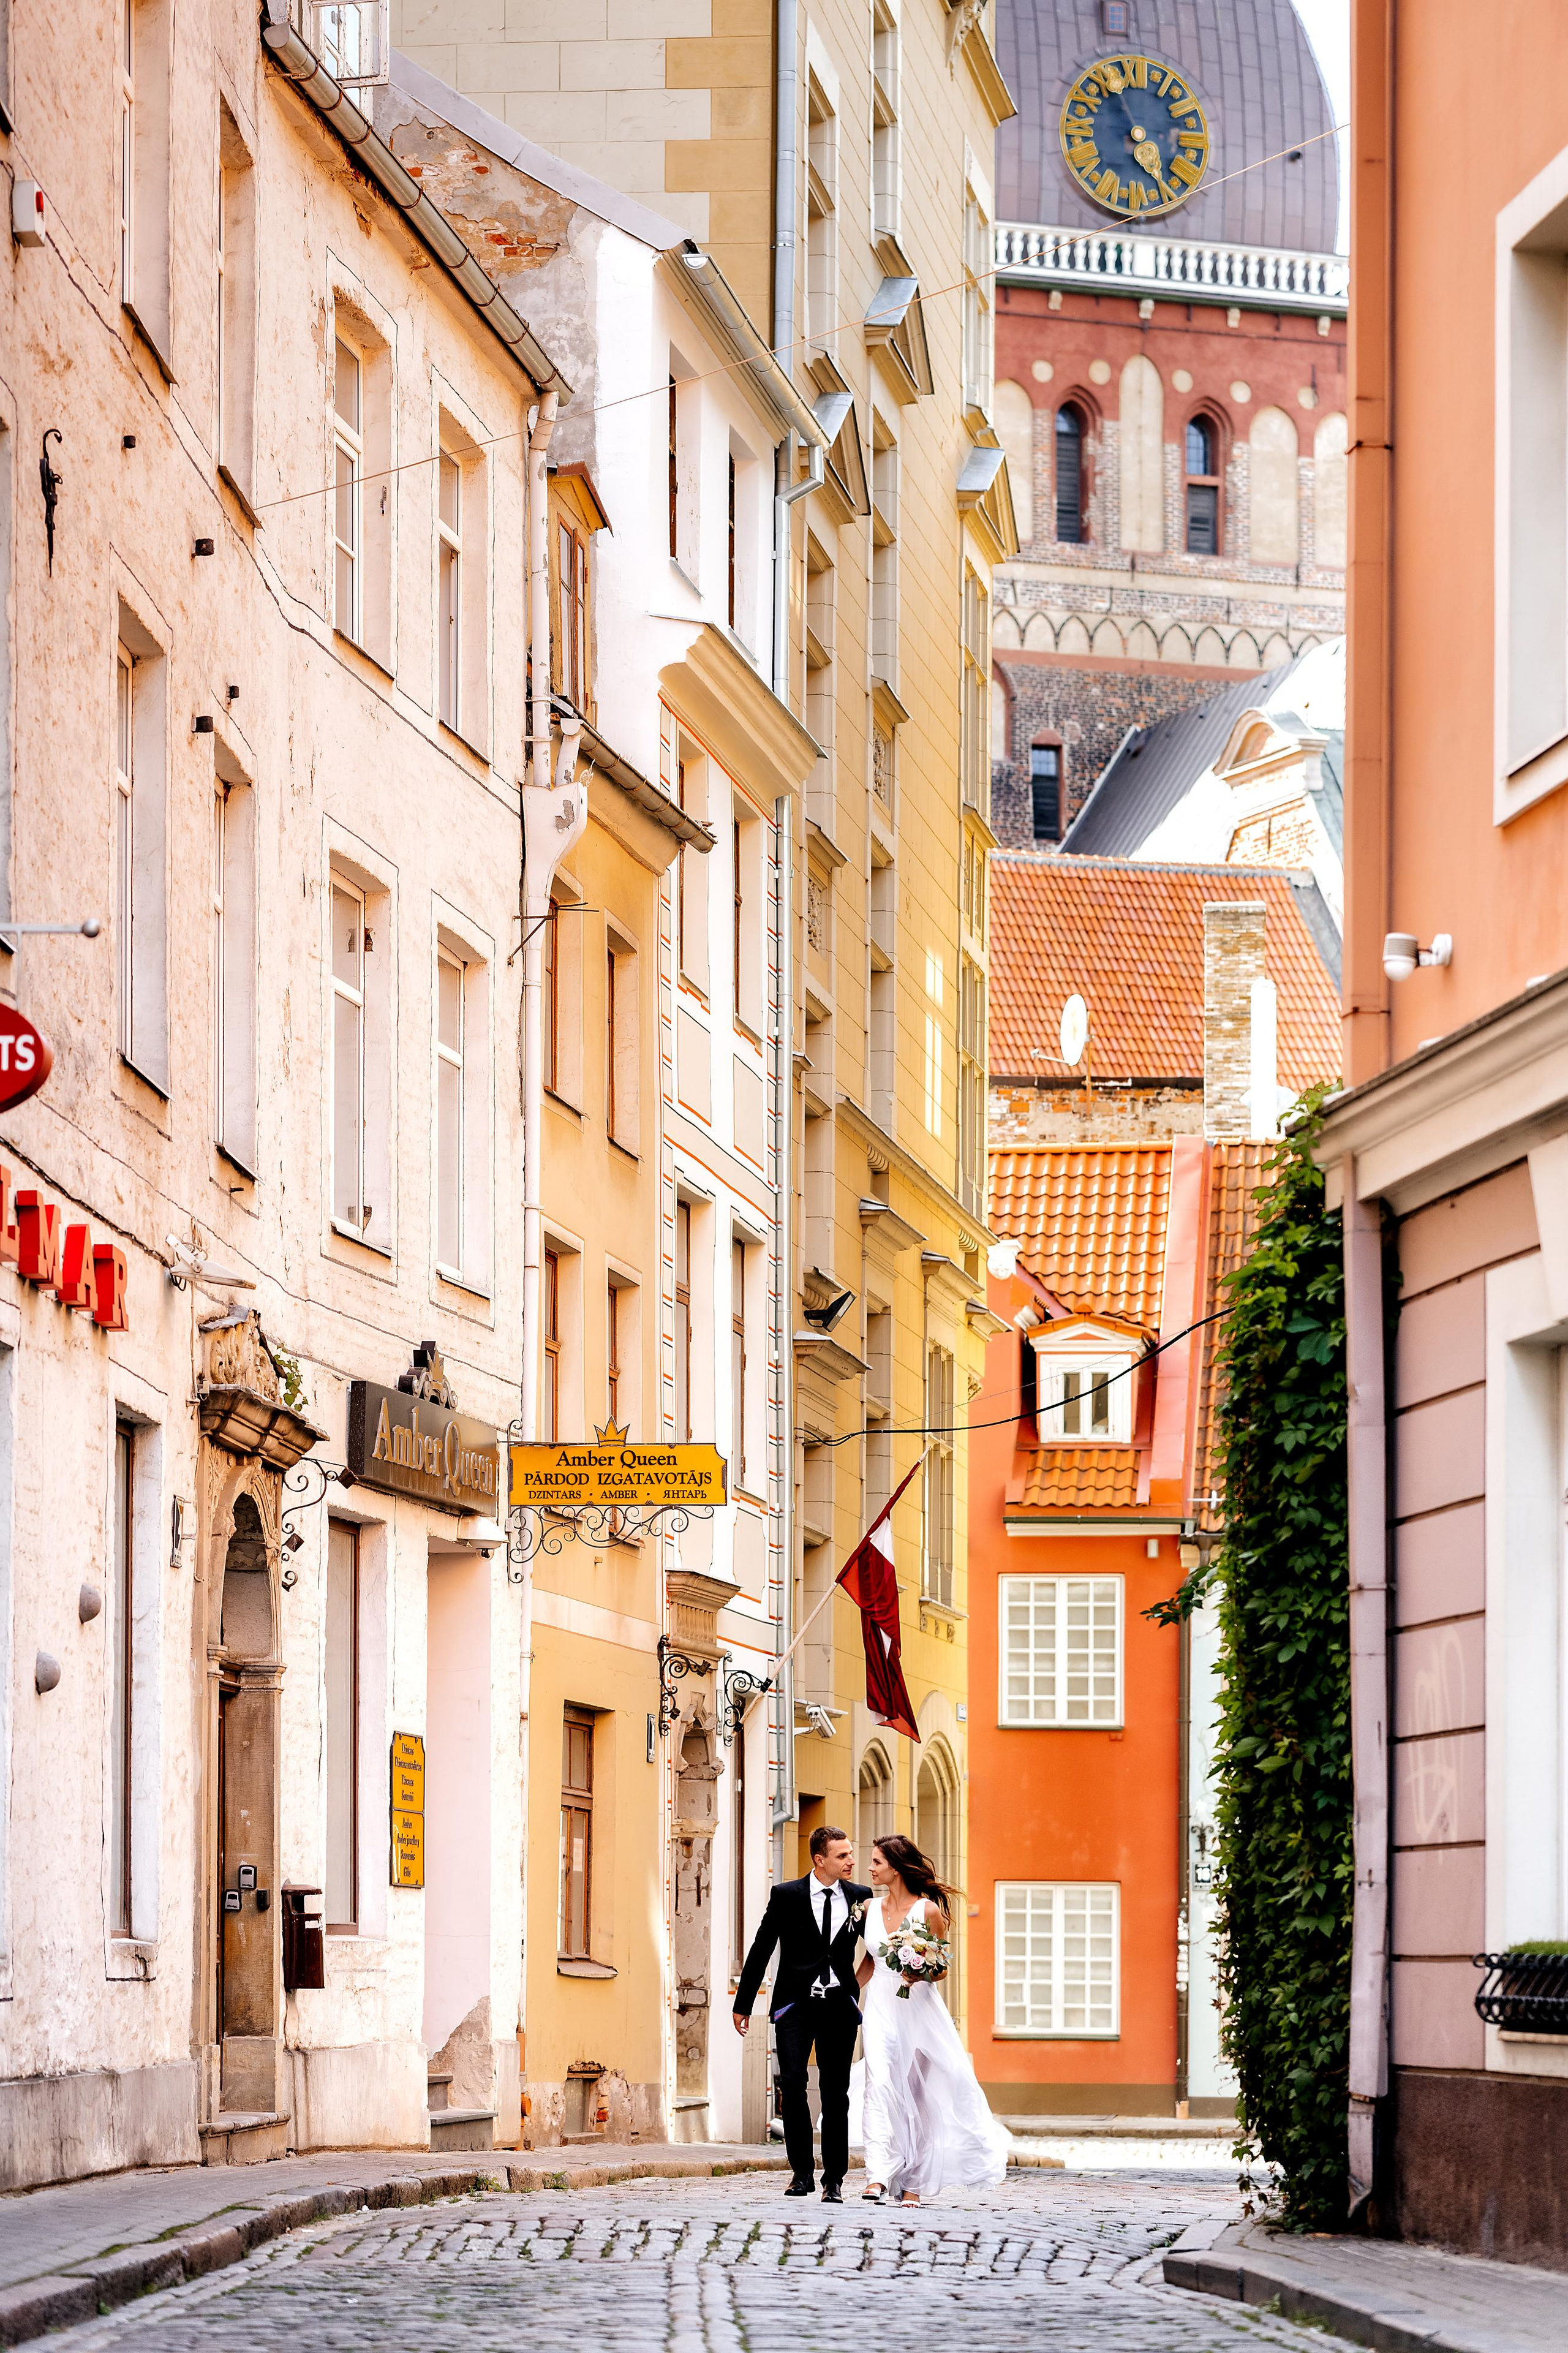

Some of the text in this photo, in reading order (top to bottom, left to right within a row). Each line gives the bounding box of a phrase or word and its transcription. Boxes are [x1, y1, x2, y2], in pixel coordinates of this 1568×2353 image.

[1121, 59, 1147, 88] XII
[1072, 87, 1102, 113] X
[0, 1034, 36, 1071] TS
[372, 1397, 494, 1497] Amber Queen
[556, 1449, 677, 1469] Amber Queen
[524, 1470, 712, 1487] PĀRDOD IZGATAVOTĀJS
[529, 1490, 638, 1499] DZINTARS AMBER
[663, 1489, 707, 1498] ЯНТАРЬ
